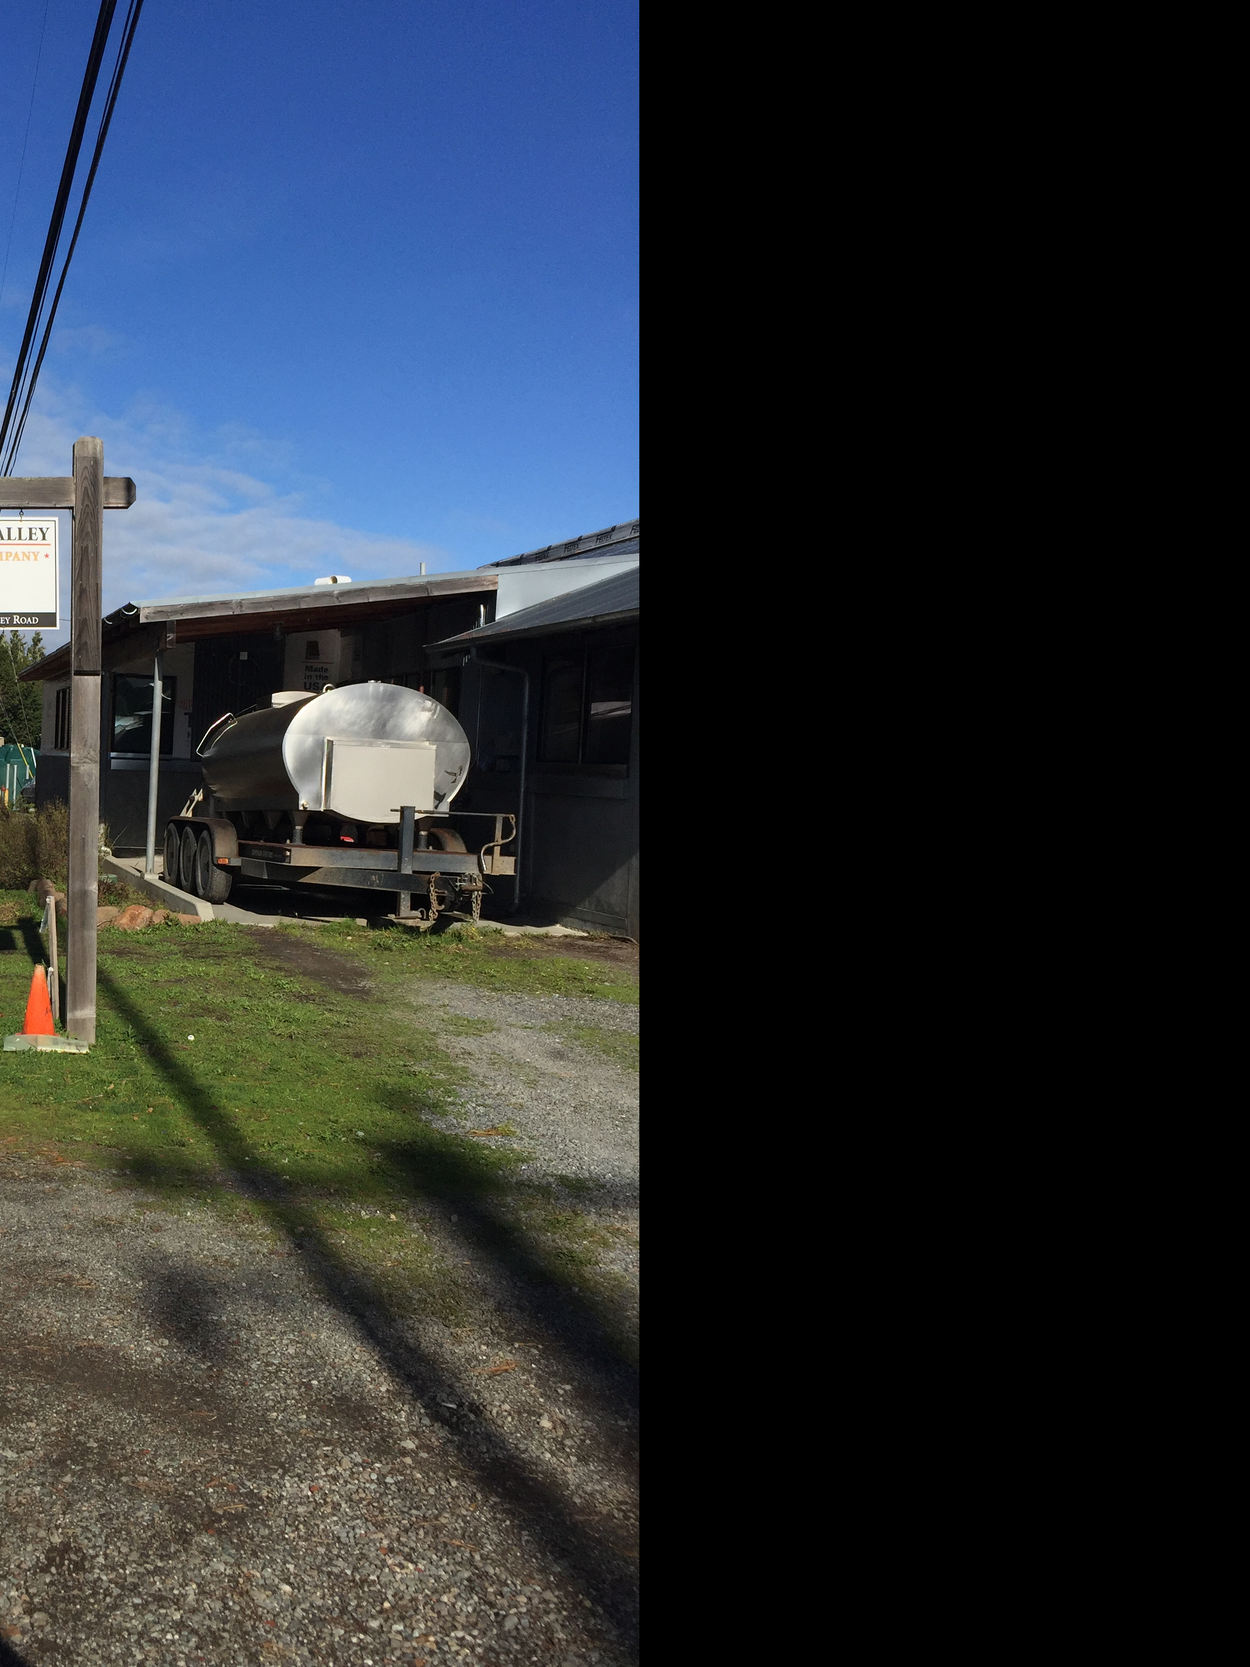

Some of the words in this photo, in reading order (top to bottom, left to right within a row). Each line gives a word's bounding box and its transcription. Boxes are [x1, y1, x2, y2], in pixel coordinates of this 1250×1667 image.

[13, 615, 39, 625] ROAD
[304, 665, 329, 673] Made
[315, 673, 329, 681] the
